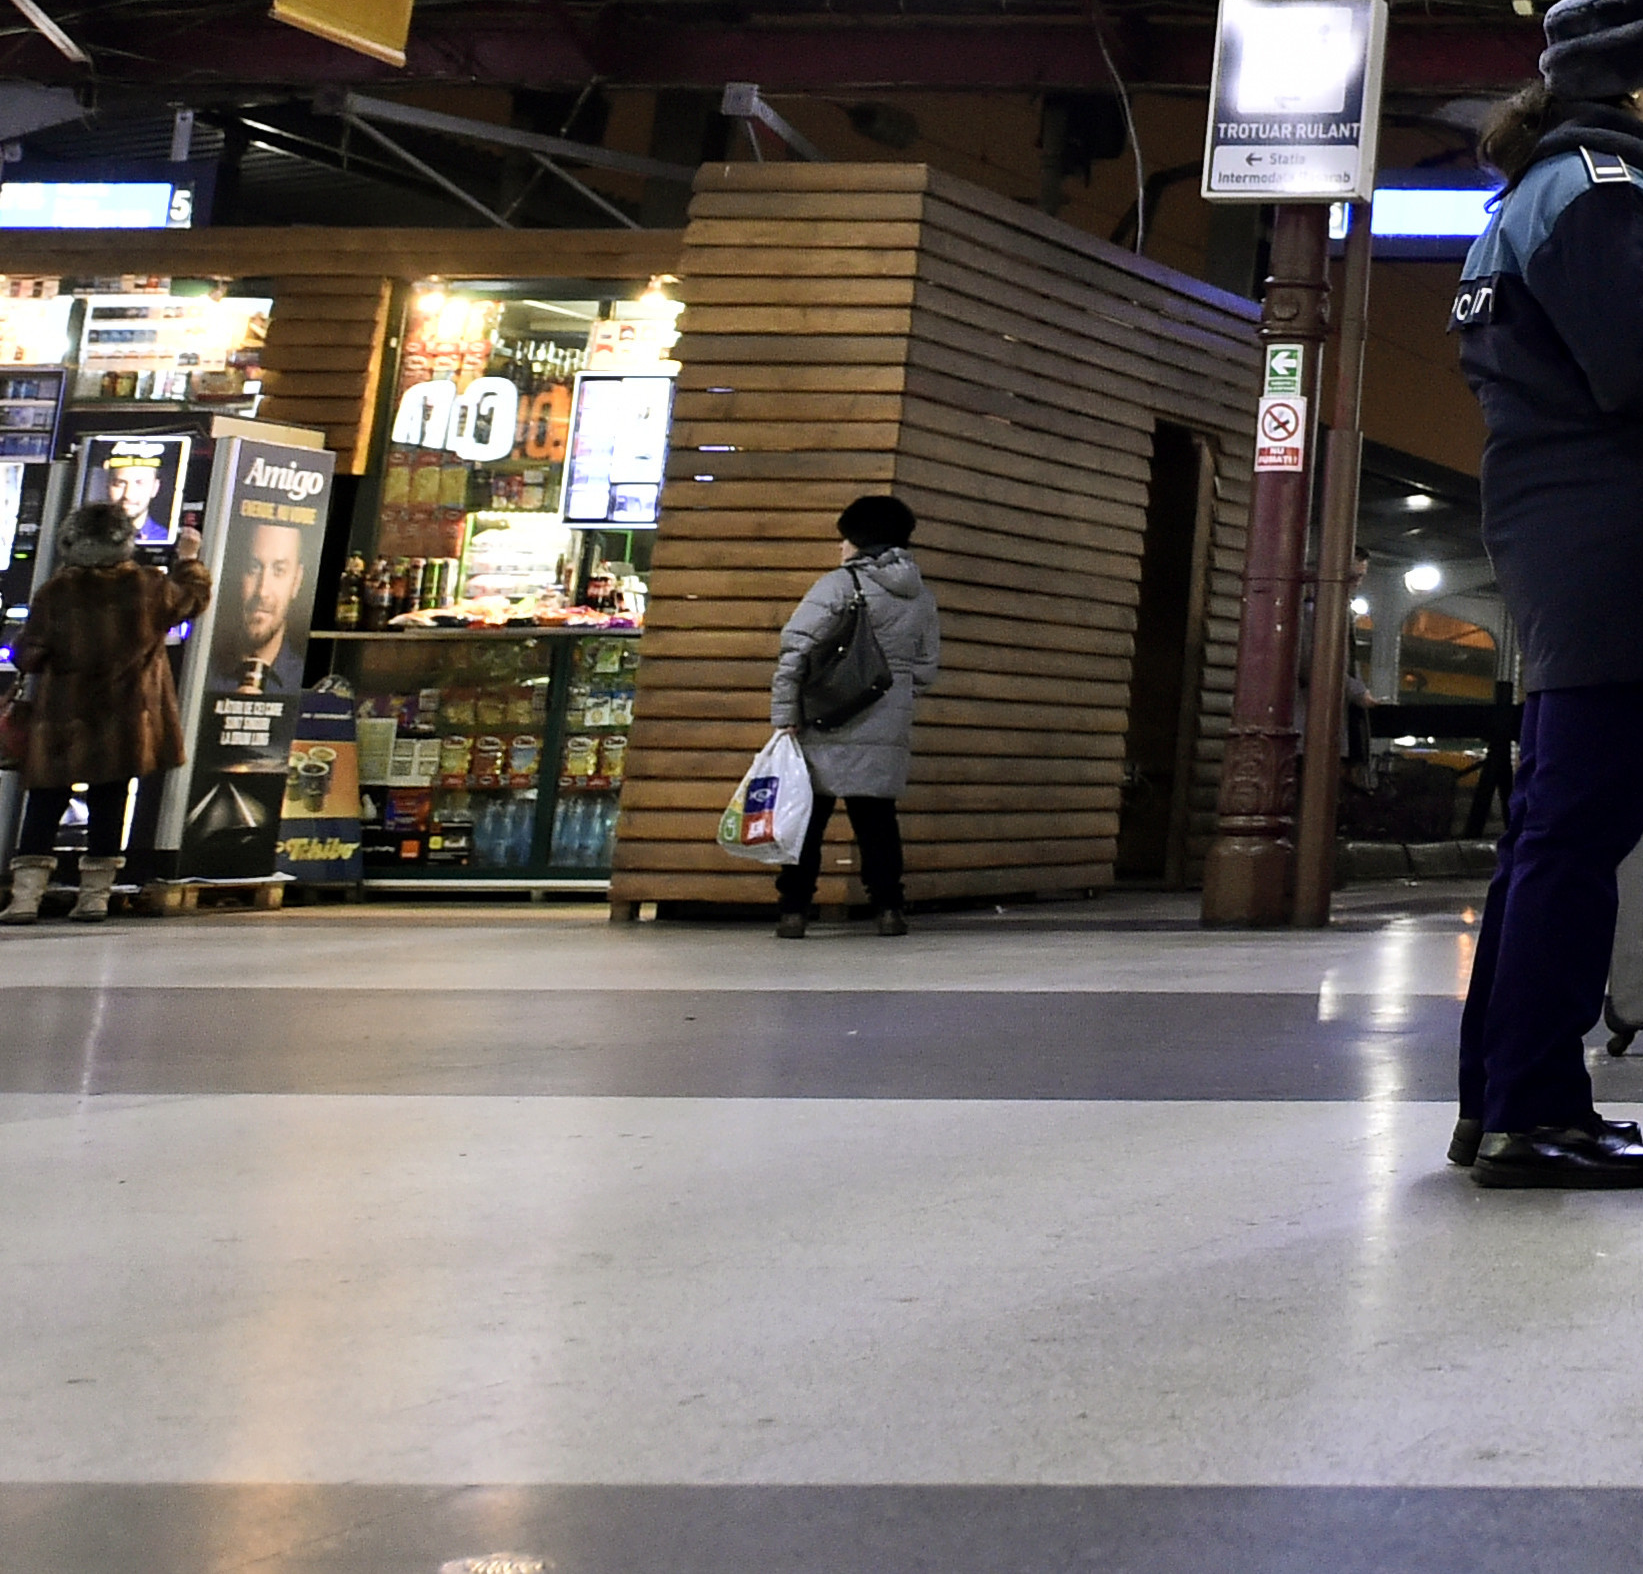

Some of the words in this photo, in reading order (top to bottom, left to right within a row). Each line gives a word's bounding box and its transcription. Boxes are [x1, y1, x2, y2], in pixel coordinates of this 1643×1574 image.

[1217, 122, 1292, 139] TROTUAR
[1295, 122, 1361, 139] RULANT
[169, 189, 192, 222] 5
[243, 457, 324, 501] Amigo
